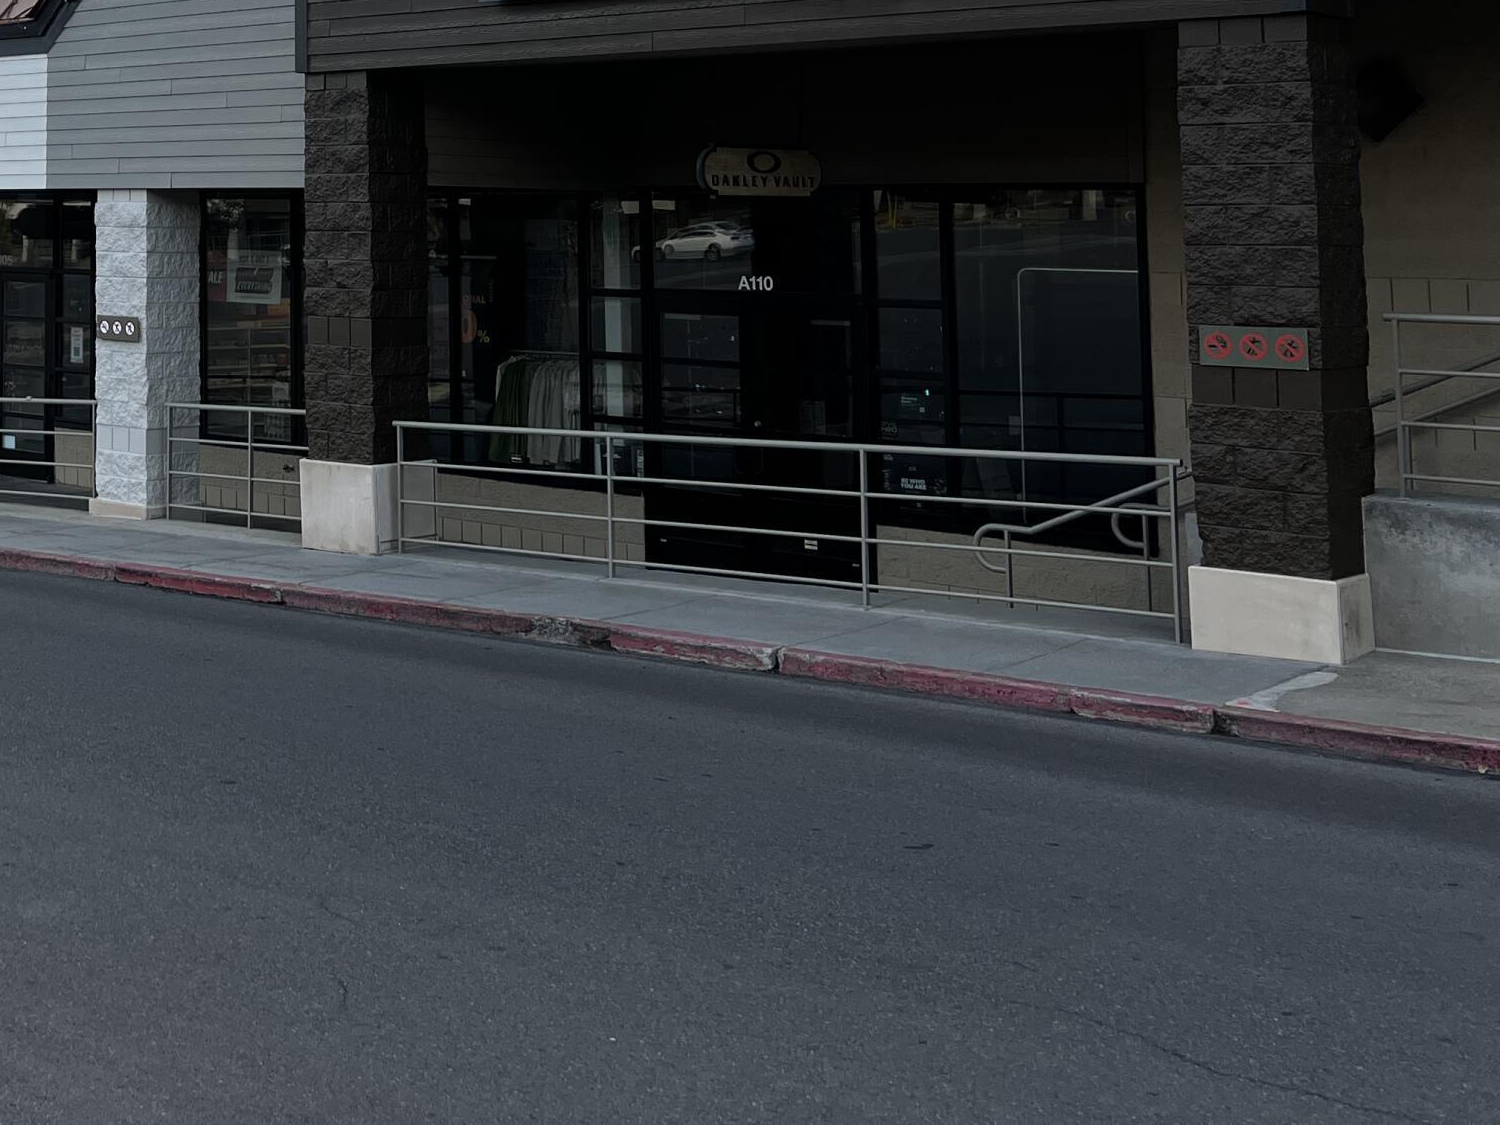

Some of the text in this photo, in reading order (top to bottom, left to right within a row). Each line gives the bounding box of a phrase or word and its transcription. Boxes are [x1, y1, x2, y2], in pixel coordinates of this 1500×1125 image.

[711, 174, 816, 188] OAKLEY VAULT
[738, 275, 774, 291] A110
